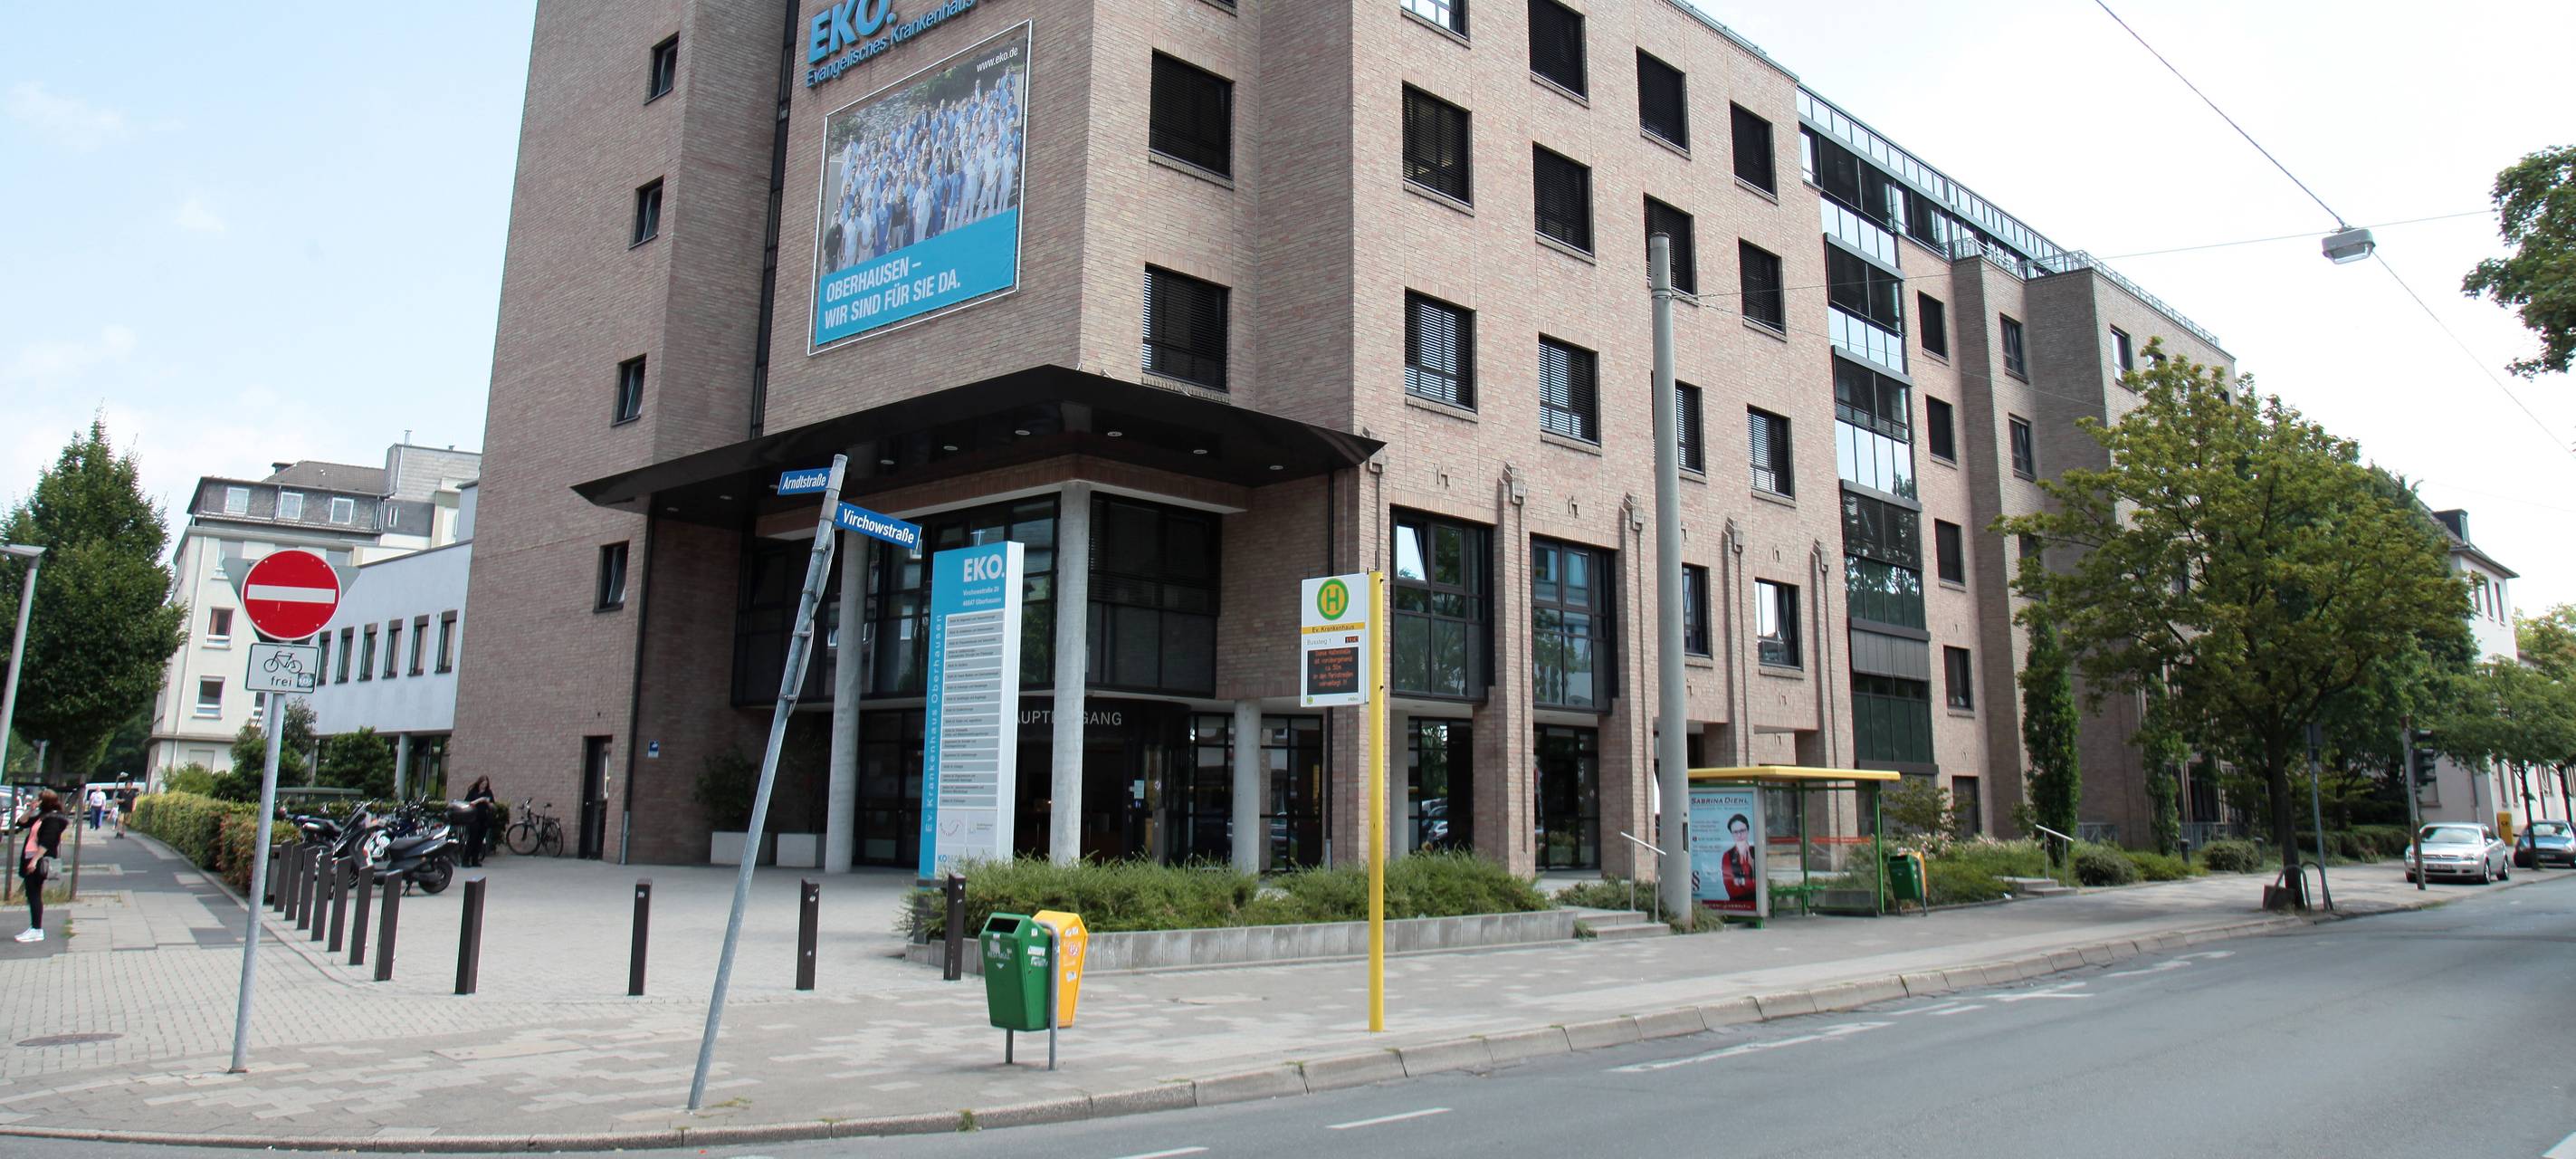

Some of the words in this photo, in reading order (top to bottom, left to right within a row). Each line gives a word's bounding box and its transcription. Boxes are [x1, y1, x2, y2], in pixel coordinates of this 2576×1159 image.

[808, 0, 898, 64] EKO.
[806, 36, 887, 88] Evangelisches
[977, 46, 1018, 72] www.eko.de
[826, 256, 910, 303] OBERHAUSEN
[825, 304, 848, 330] WIR
[851, 293, 881, 321] SIND
[884, 283, 910, 311] FÜR
[913, 275, 935, 302] SIE
[938, 268, 961, 293] DA.
[782, 473, 826, 490] Arndtstraße
[843, 508, 915, 544] Virchowstraße
[963, 553, 1006, 583] EKO.
[1326, 588, 1340, 611] H
[1321, 624, 1355, 634] Krankenhaus
[930, 615, 942, 704] Oberhausen
[271, 675, 292, 686] frei
[1016, 710, 1122, 726] UPTGANG
[927, 709, 939, 808] Krankenhaus
[1691, 796, 1723, 805] SABRINA
[1724, 796, 1748, 804] DIEHL
